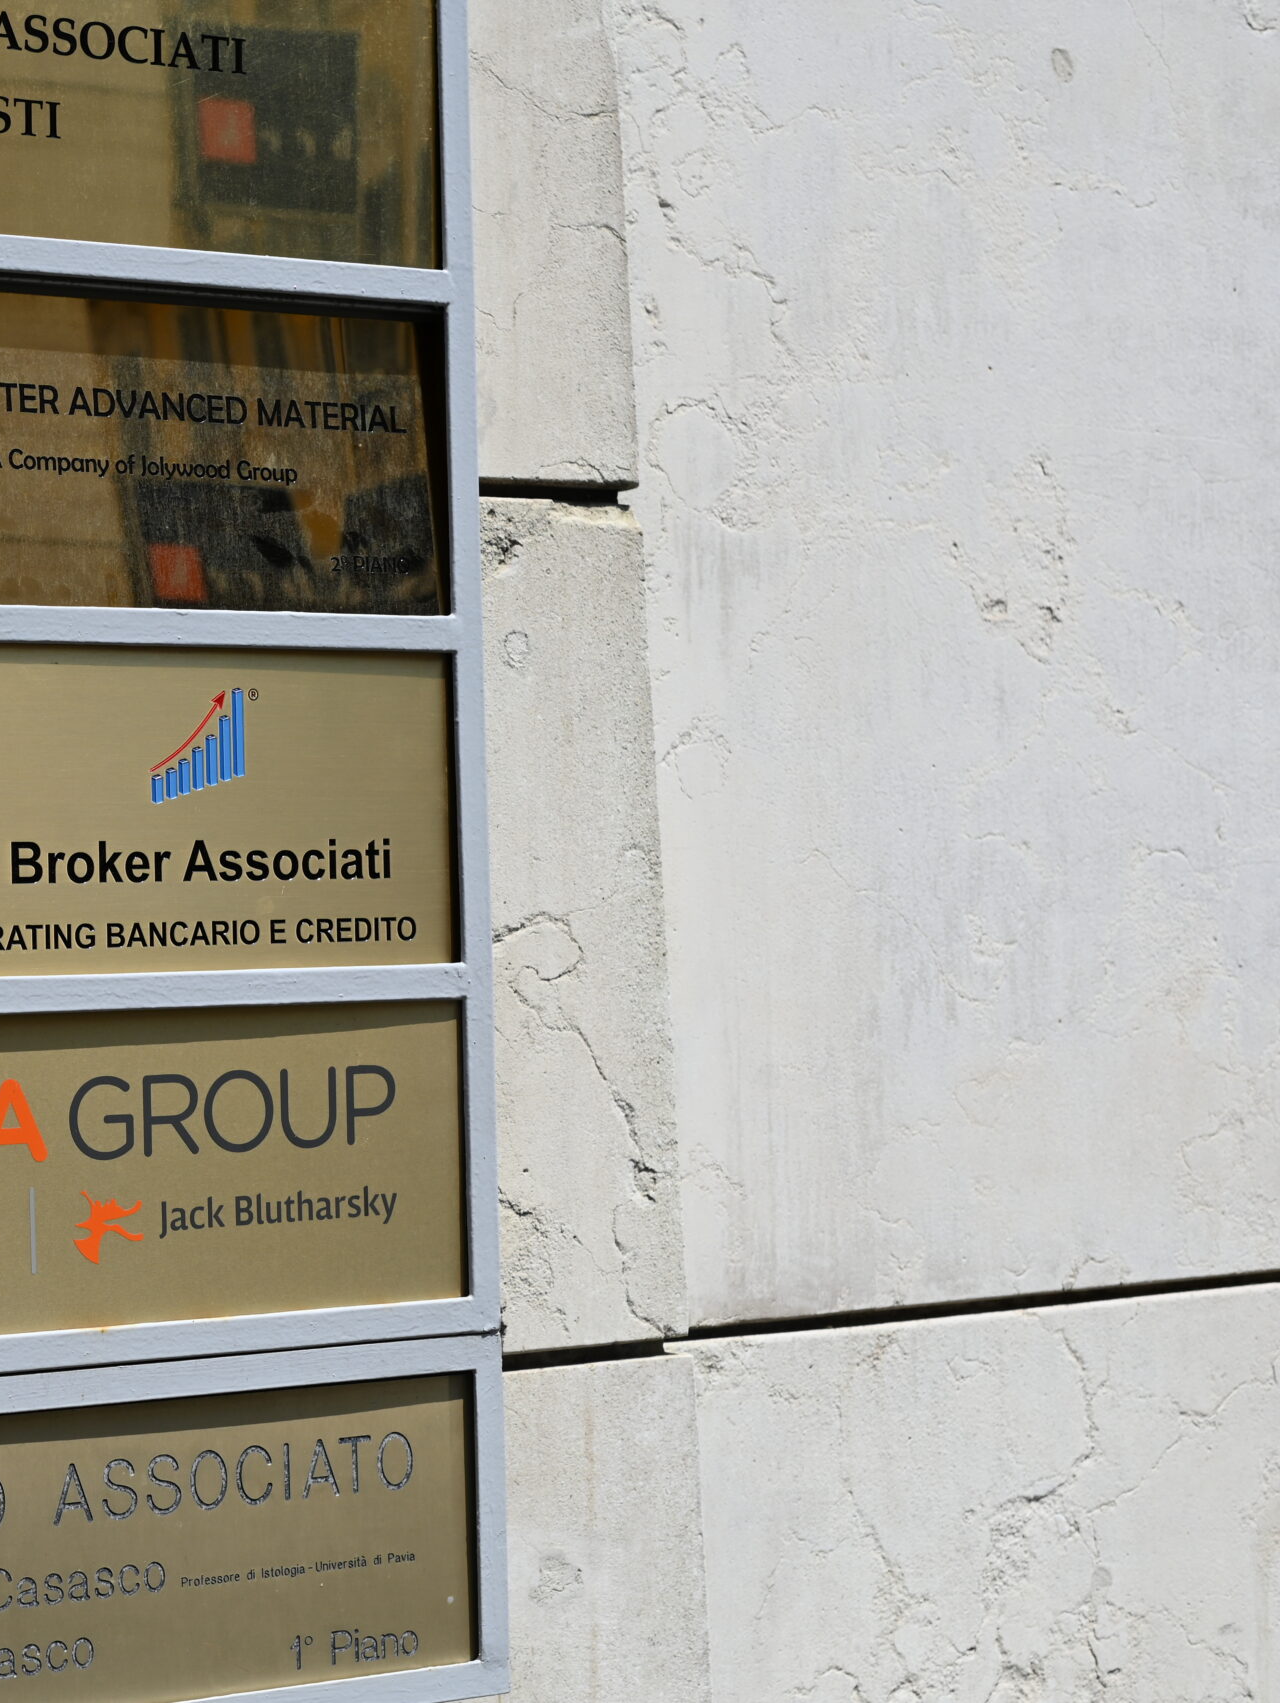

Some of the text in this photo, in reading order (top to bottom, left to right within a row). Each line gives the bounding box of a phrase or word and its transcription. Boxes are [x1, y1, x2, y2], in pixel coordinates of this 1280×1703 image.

[69, 386, 247, 426] ADVANCED
[257, 397, 407, 435] MATERIAL
[9, 449, 109, 477] Company
[115, 454, 136, 478] of
[141, 455, 232, 482] Jolywood
[235, 462, 297, 488] Group
[11, 838, 390, 884] Broker Associati
[107, 920, 260, 948] BANCARIO
[270, 919, 286, 944] E
[296, 916, 416, 943] CREDITO
[69, 1065, 395, 1160] GROUP
[160, 1186, 397, 1239] Jack Blutharsky
[53, 1431, 413, 1524] ASSOCIATO
[180, 1572, 241, 1588] Professore
[246, 1568, 257, 1581] di
[372, 1554, 383, 1566] di
[386, 1551, 417, 1564] Pavia
[331, 1629, 418, 1665] Piano
